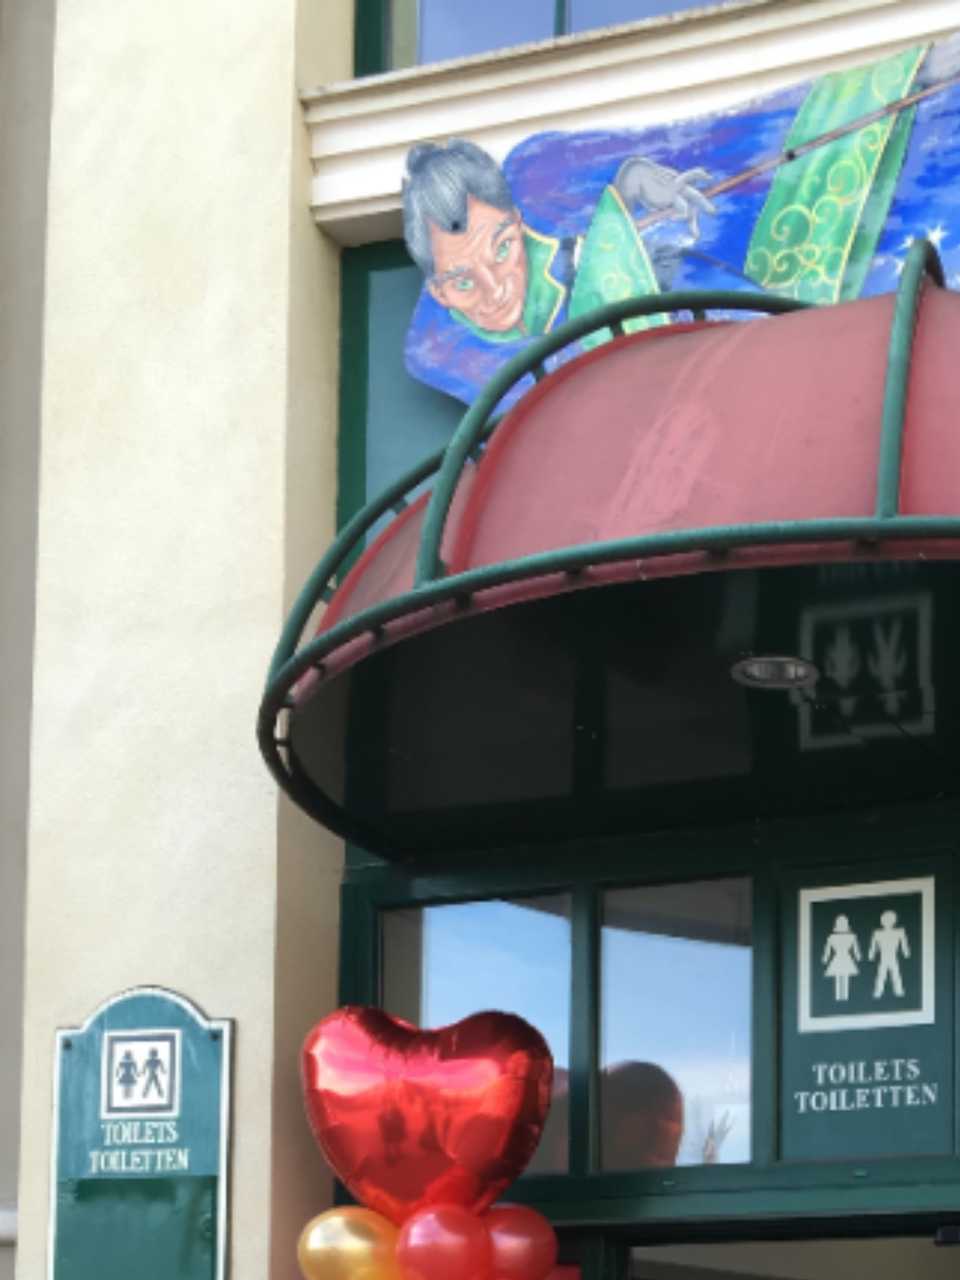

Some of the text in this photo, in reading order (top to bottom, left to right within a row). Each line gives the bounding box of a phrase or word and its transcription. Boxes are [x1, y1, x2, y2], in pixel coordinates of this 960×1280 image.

[811, 1058, 921, 1085] TOILETS
[794, 1083, 939, 1114] TOILETTEN
[101, 1120, 179, 1146] TOILETS
[89, 1147, 190, 1174] TOILETTEN
